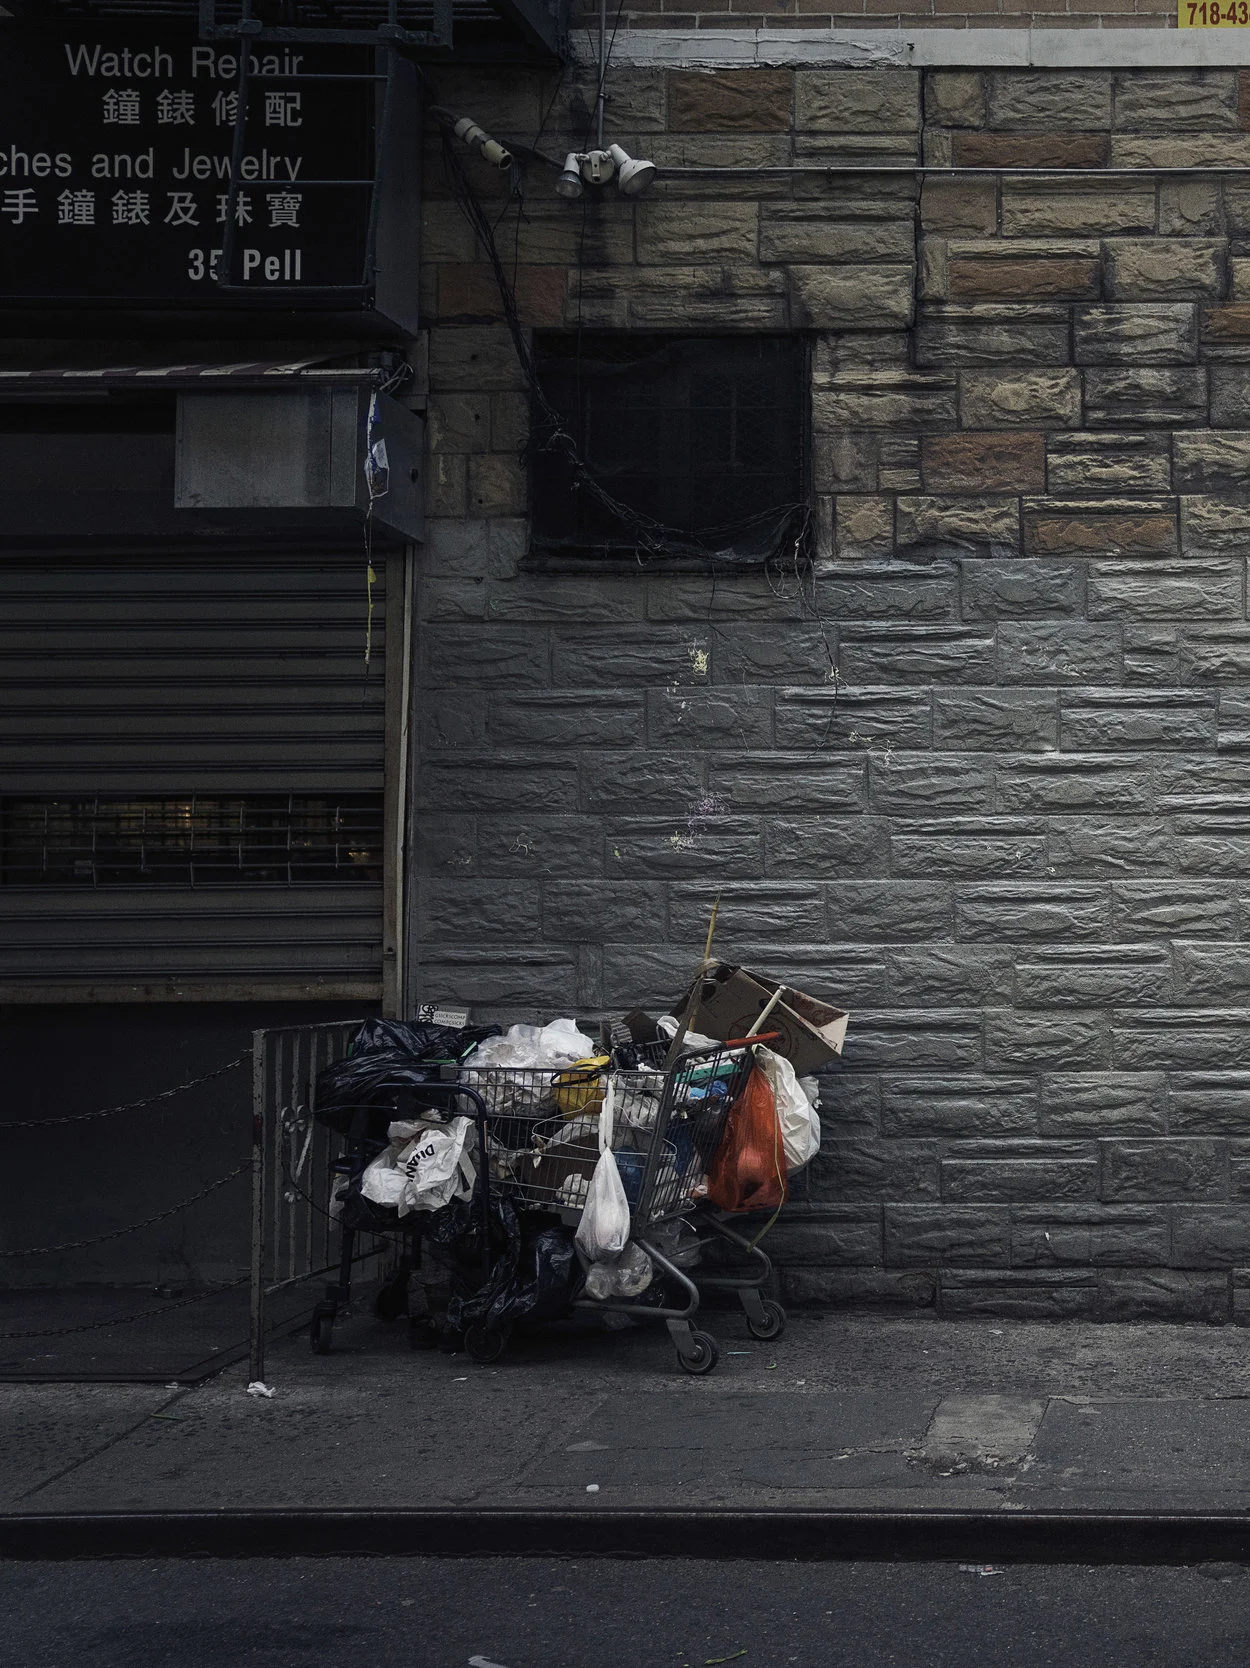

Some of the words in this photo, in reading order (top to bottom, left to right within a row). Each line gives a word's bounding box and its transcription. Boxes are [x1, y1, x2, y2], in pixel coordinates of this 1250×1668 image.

[64, 43, 173, 78] Watch
[91, 147, 154, 178] and
[172, 147, 303, 188] Jewelry
[188, 248, 224, 280] 35
[243, 248, 302, 280] Pell
[405, 1144, 435, 1182] DUAN
